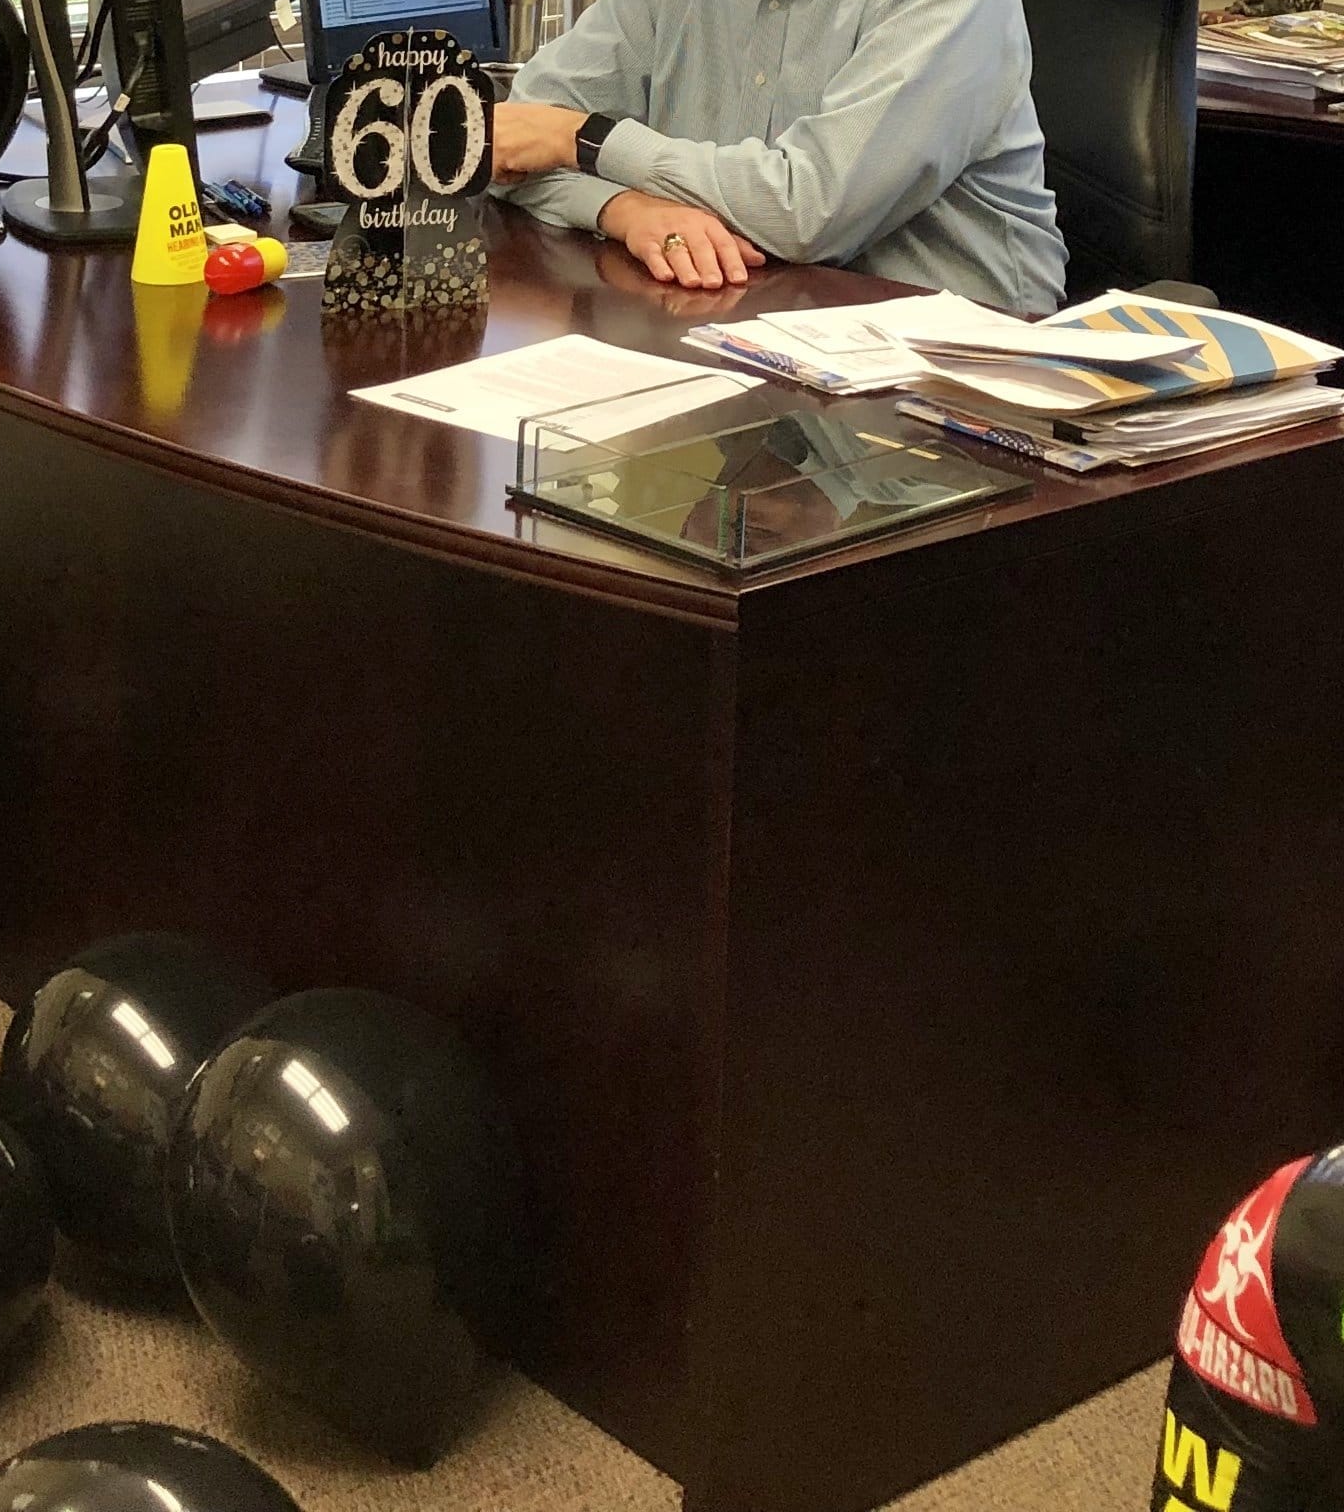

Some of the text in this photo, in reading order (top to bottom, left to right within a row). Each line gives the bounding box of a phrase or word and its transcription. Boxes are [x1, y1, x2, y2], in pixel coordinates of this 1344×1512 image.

[378, 42, 448, 74] happy
[331, 75, 487, 199] 60
[169, 201, 199, 220] OLD
[359, 199, 458, 232] birthday
